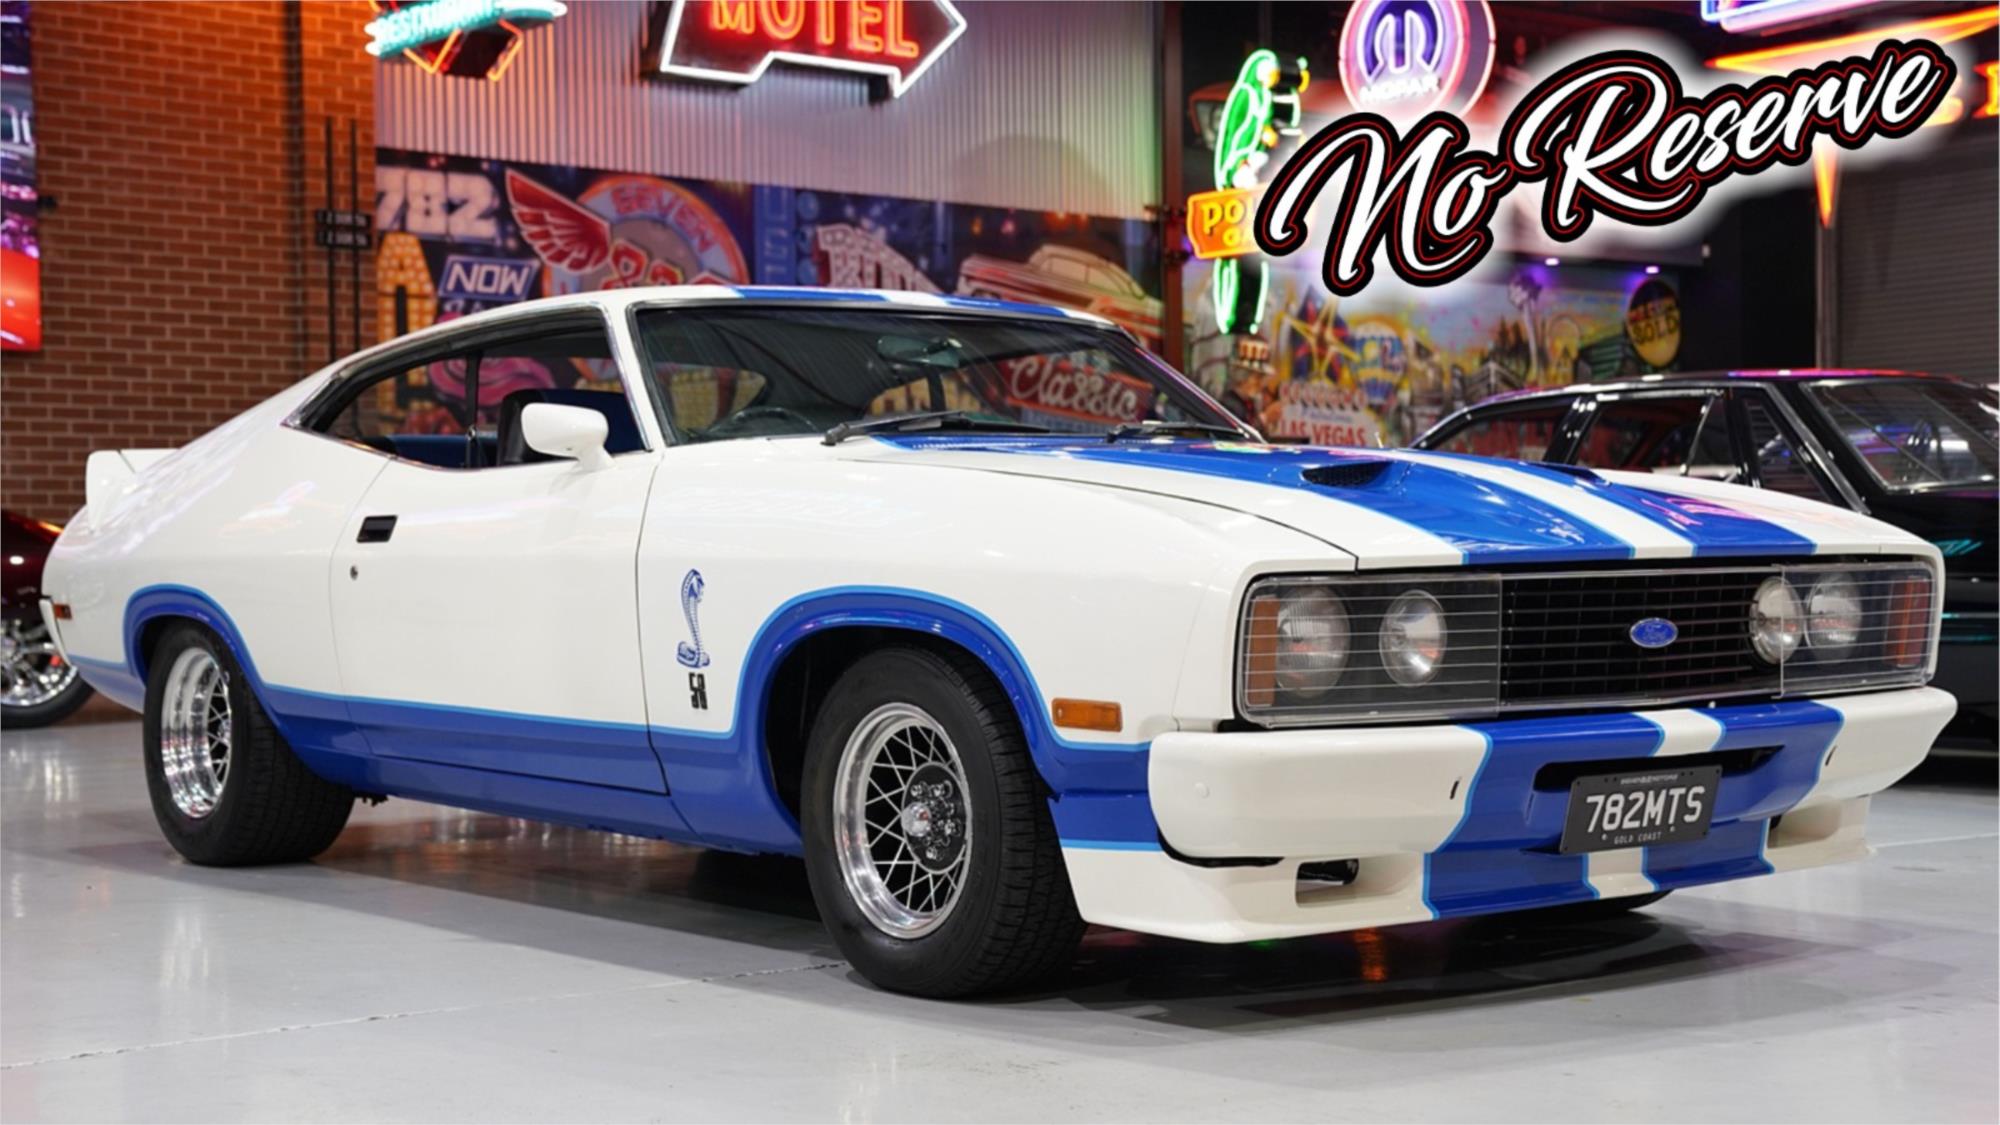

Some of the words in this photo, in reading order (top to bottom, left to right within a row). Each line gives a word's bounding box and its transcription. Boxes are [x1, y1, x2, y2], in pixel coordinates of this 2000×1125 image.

[709, 0, 919, 58] MOTEL
[375, 166, 499, 238] 782
[447, 263, 529, 296] NOW
[1008, 356, 1138, 421] Classic
[1311, 423, 1366, 446] VEGAS
[1585, 785, 1705, 834] 782MTS
[1614, 834, 1634, 845] GOLD
[1638, 831, 1662, 843] COAST
